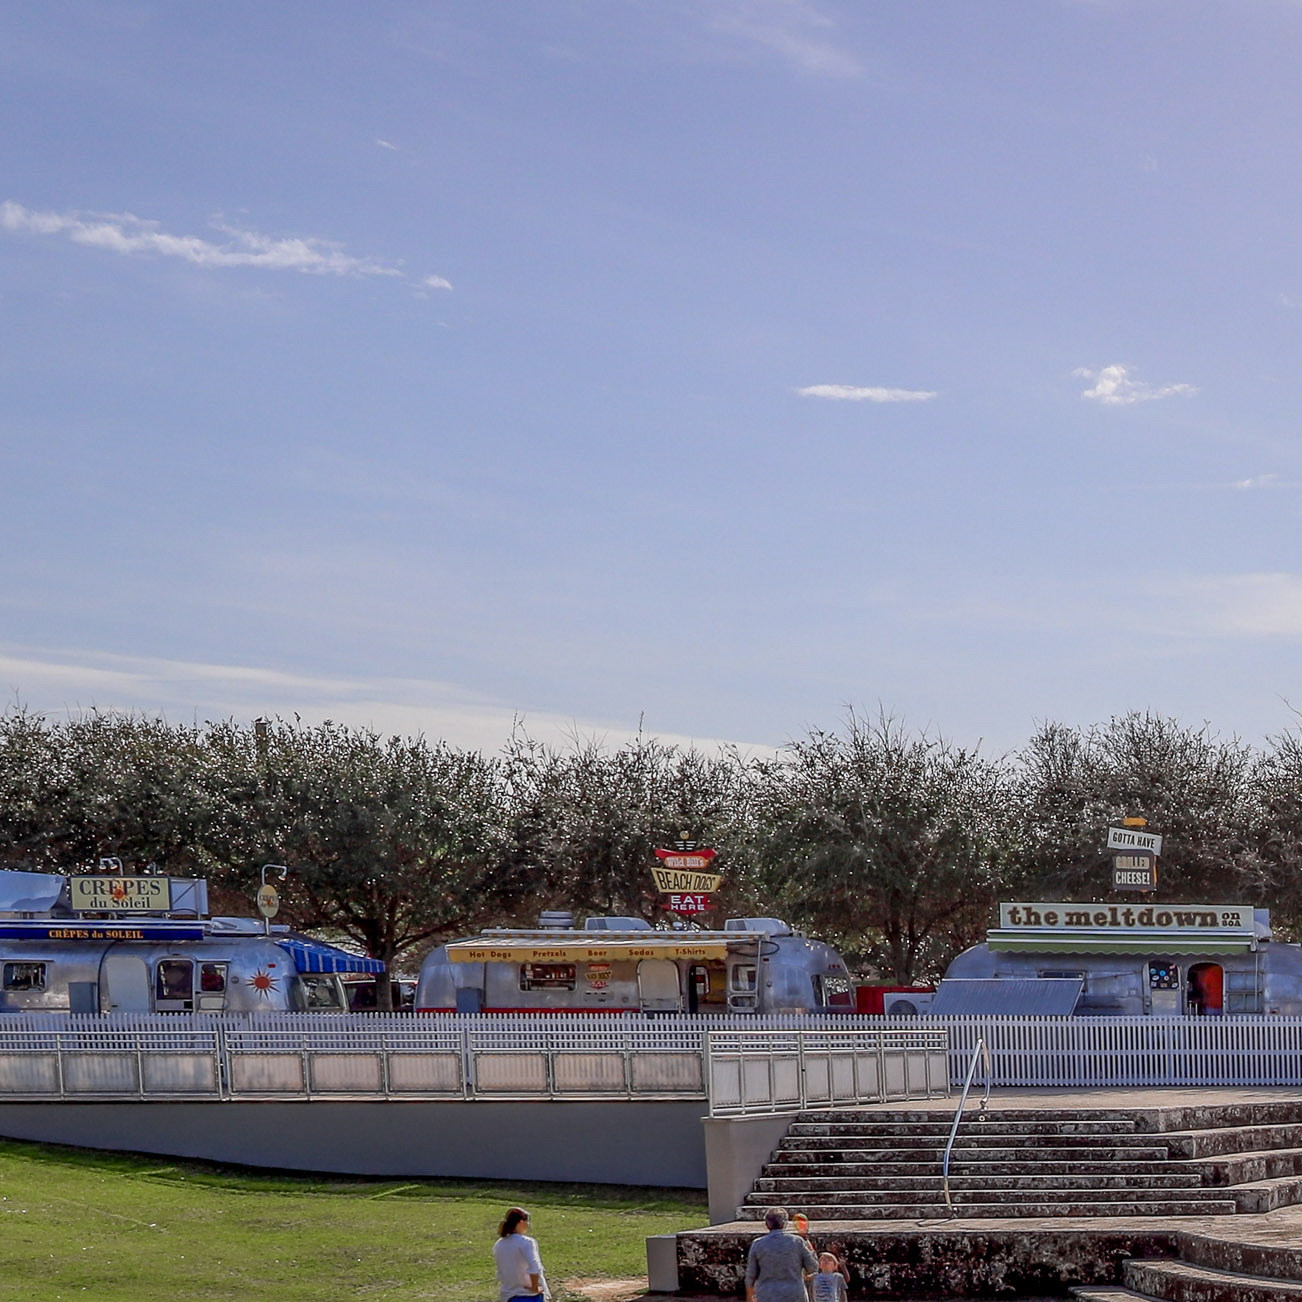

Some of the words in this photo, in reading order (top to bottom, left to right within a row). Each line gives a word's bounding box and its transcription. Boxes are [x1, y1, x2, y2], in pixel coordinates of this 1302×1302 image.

[1112, 831, 1135, 846] GOTTA
[1137, 836, 1156, 849] HAVE
[656, 870, 693, 890] BEACH
[693, 875, 715, 890] DOGS
[1115, 871, 1151, 885] CHEESE!
[90, 896, 107, 908] du
[112, 897, 151, 908] Soleil
[670, 895, 705, 904] EAT
[1007, 906, 1059, 927] the
[1065, 907, 1220, 928] meltdown
[1221, 912, 1241, 920] on
[49, 928, 89, 938] CRÊPES
[91, 930, 103, 938] du
[105, 930, 144, 939] SOLEIL
